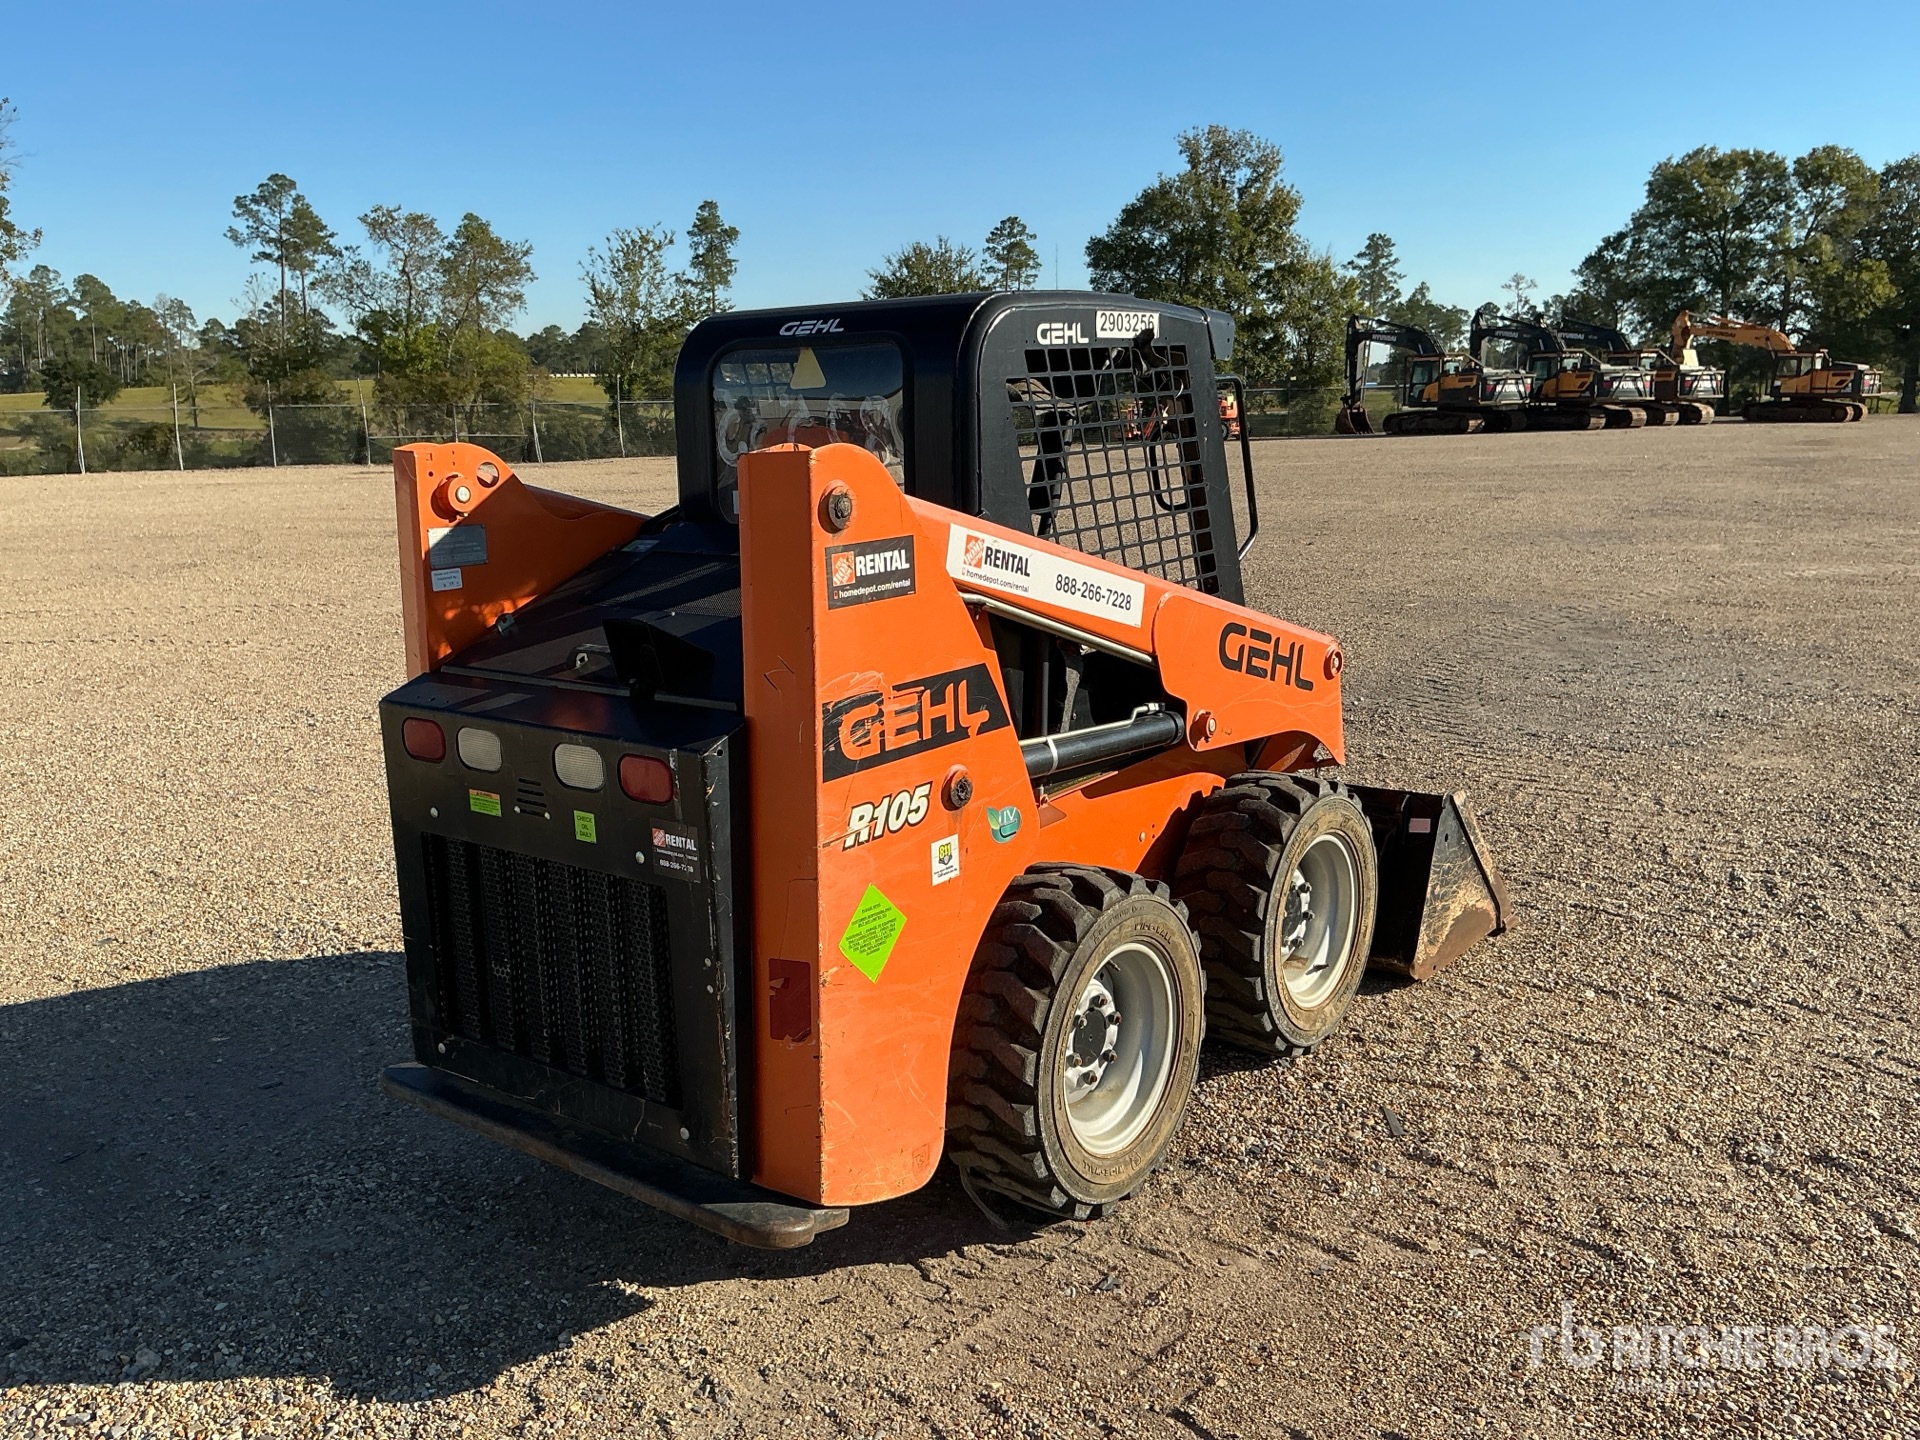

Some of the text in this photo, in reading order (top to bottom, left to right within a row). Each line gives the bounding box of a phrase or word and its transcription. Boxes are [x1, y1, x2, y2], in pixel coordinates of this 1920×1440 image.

[779, 318, 845, 336] GEHL
[1036, 322, 1090, 345] GEHL
[1100, 312, 1155, 332] 2903256
[855, 549, 910, 577] RENTAL
[984, 546, 1031, 577] RENTAL
[839, 578, 911, 598] homedepot.com/rental
[966, 569, 1030, 592] homedepot.com/rental
[1055, 573, 1132, 611] 888-266-7228
[1218, 622, 1314, 692] GEHL
[839, 679, 990, 761] GEHL
[844, 782, 931, 850] R105
[665, 834, 697, 851] RENTAL
